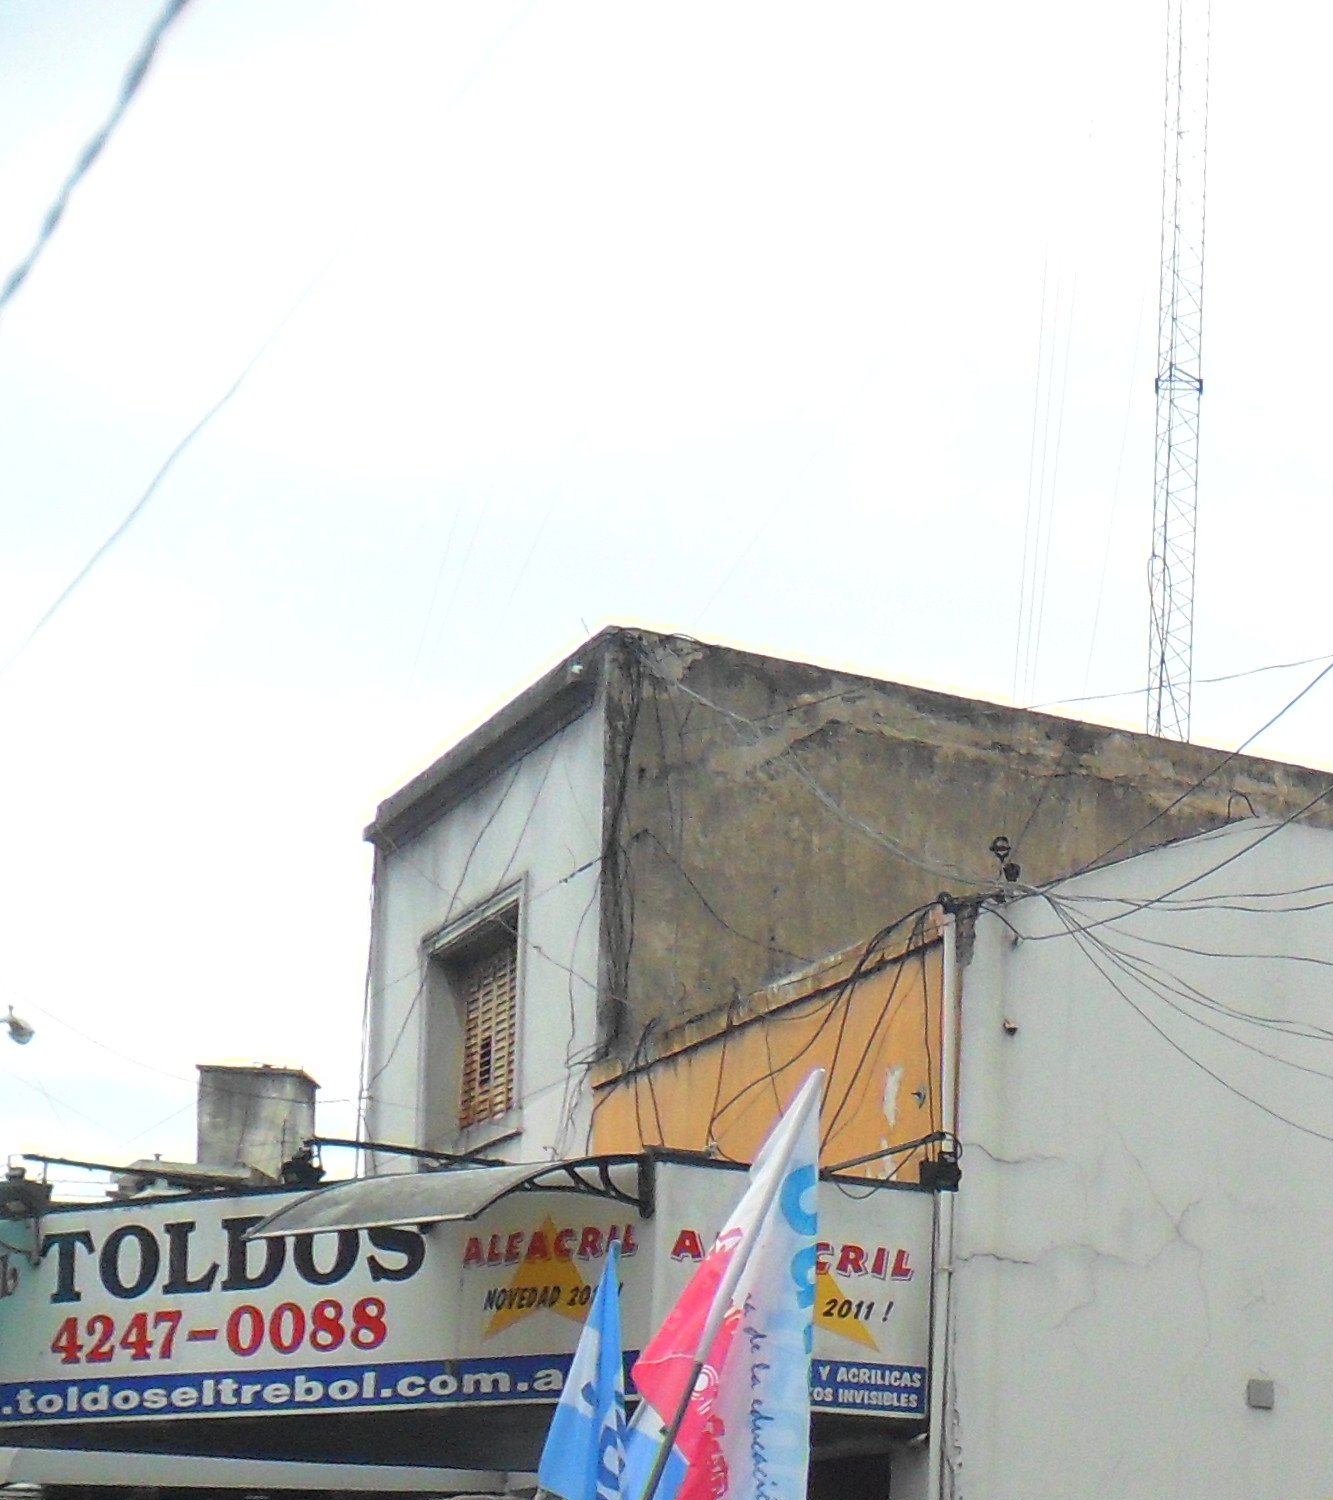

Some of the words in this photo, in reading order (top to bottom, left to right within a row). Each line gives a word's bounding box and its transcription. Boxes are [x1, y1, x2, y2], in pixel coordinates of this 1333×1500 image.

[40, 1214, 426, 1303] TOLDOS
[463, 1224, 639, 1269] ALEACRIL
[484, 1285, 562, 1311] NOVEDAD
[823, 1299, 875, 1321] 2011
[51, 1297, 388, 1364] 4247-0088
[2, 1368, 564, 1416] .toldoseltrebol.com.a
[819, 1364, 831, 1381] Y
[836, 1366, 922, 1388] ACRILICAS
[838, 1388, 918, 1408] INVISIBLES
